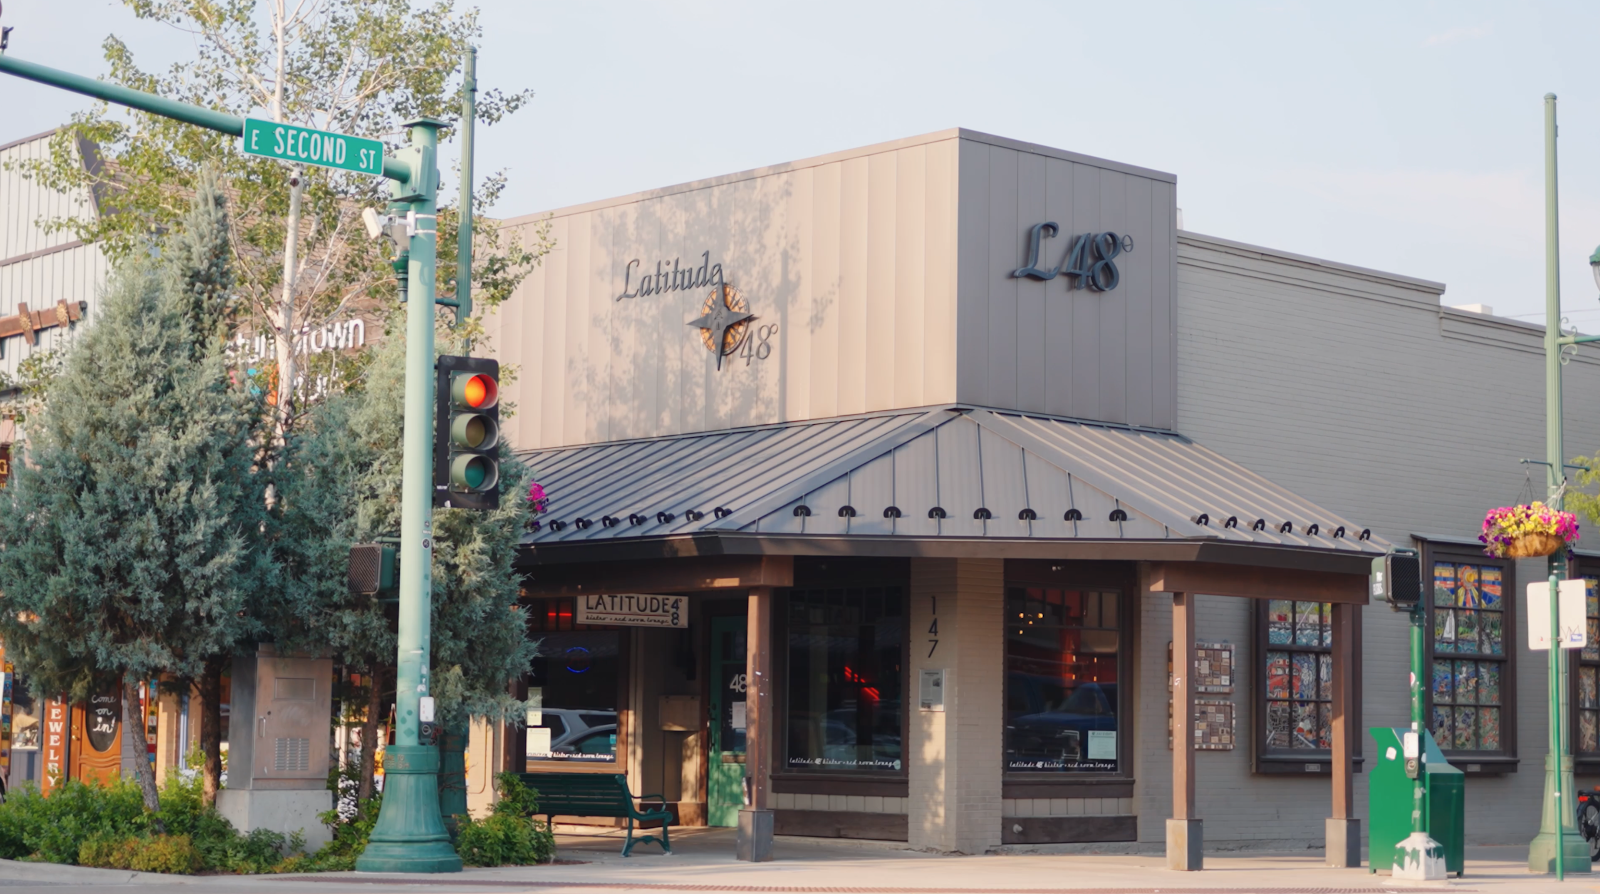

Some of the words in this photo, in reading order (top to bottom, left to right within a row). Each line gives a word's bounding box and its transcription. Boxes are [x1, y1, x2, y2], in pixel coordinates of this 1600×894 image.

[251, 129, 260, 150] E
[273, 126, 347, 165] SECOND
[359, 148, 376, 170] ST
[616, 250, 722, 302] Latitude
[586, 594, 670, 614] LATITUDE
[928, 595, 939, 658] 147
[91, 694, 116, 704] Come
[95, 707, 113, 716] on
[92, 716, 116, 733] in!
[47, 695, 64, 787] JEWELRY
